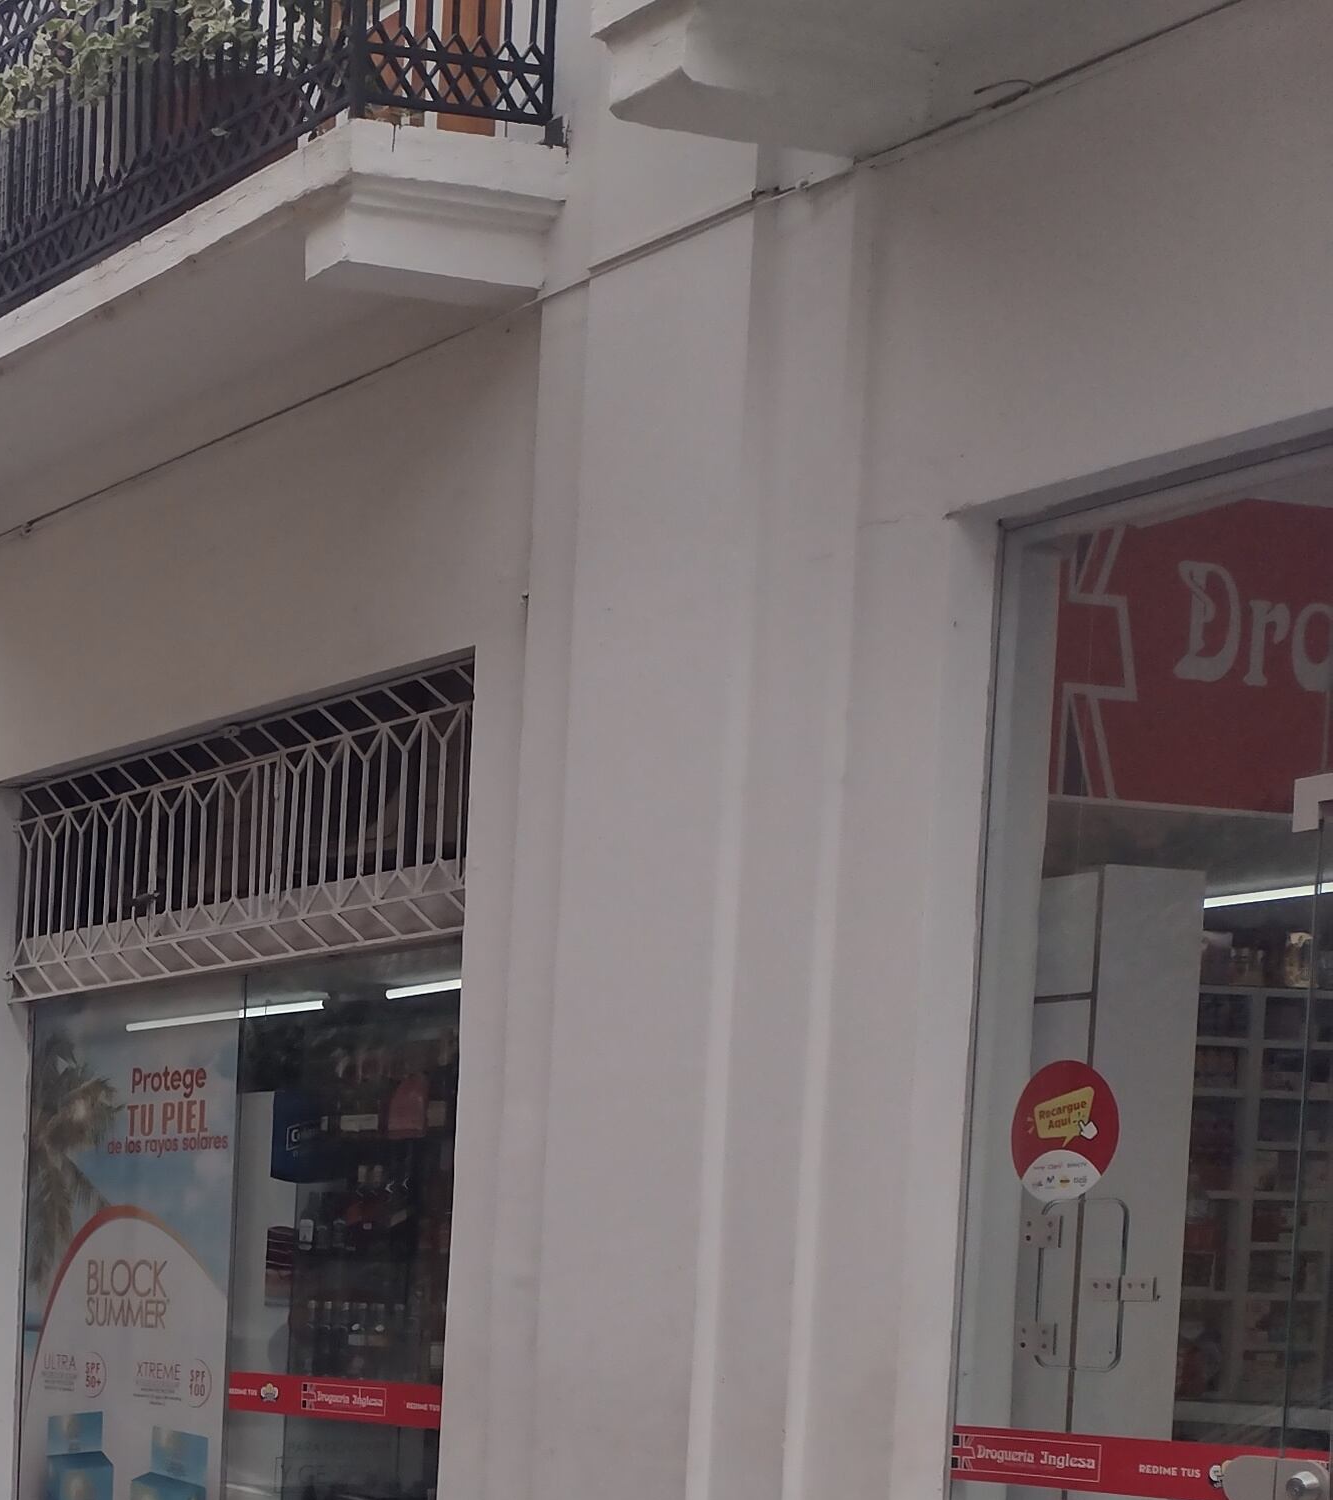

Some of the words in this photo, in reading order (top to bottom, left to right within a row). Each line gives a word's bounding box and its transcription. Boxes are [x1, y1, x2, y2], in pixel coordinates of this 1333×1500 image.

[131, 1065, 208, 1098] Protege
[127, 1103, 155, 1137] TU
[161, 1099, 208, 1135] PIEL
[1038, 1099, 1088, 1120] Recargue
[107, 1137, 123, 1155] de
[124, 1135, 142, 1154] los
[144, 1137, 179, 1158] rayos
[182, 1132, 229, 1151] solares
[85, 1258, 168, 1298] BLOCK
[84, 1296, 167, 1329] SUMMER
[43, 1353, 78, 1371] ULTRA
[84, 1361, 101, 1374] SPF
[135, 1361, 182, 1382] XTREME
[84, 1375, 102, 1389] 50+
[189, 1369, 206, 1383] SPF
[188, 1383, 206, 1398] 100
[1040, 1450, 1096, 1470] Inglesa
[1138, 1464, 1178, 1477] REDIME
[1180, 1467, 1202, 1479] TUS
